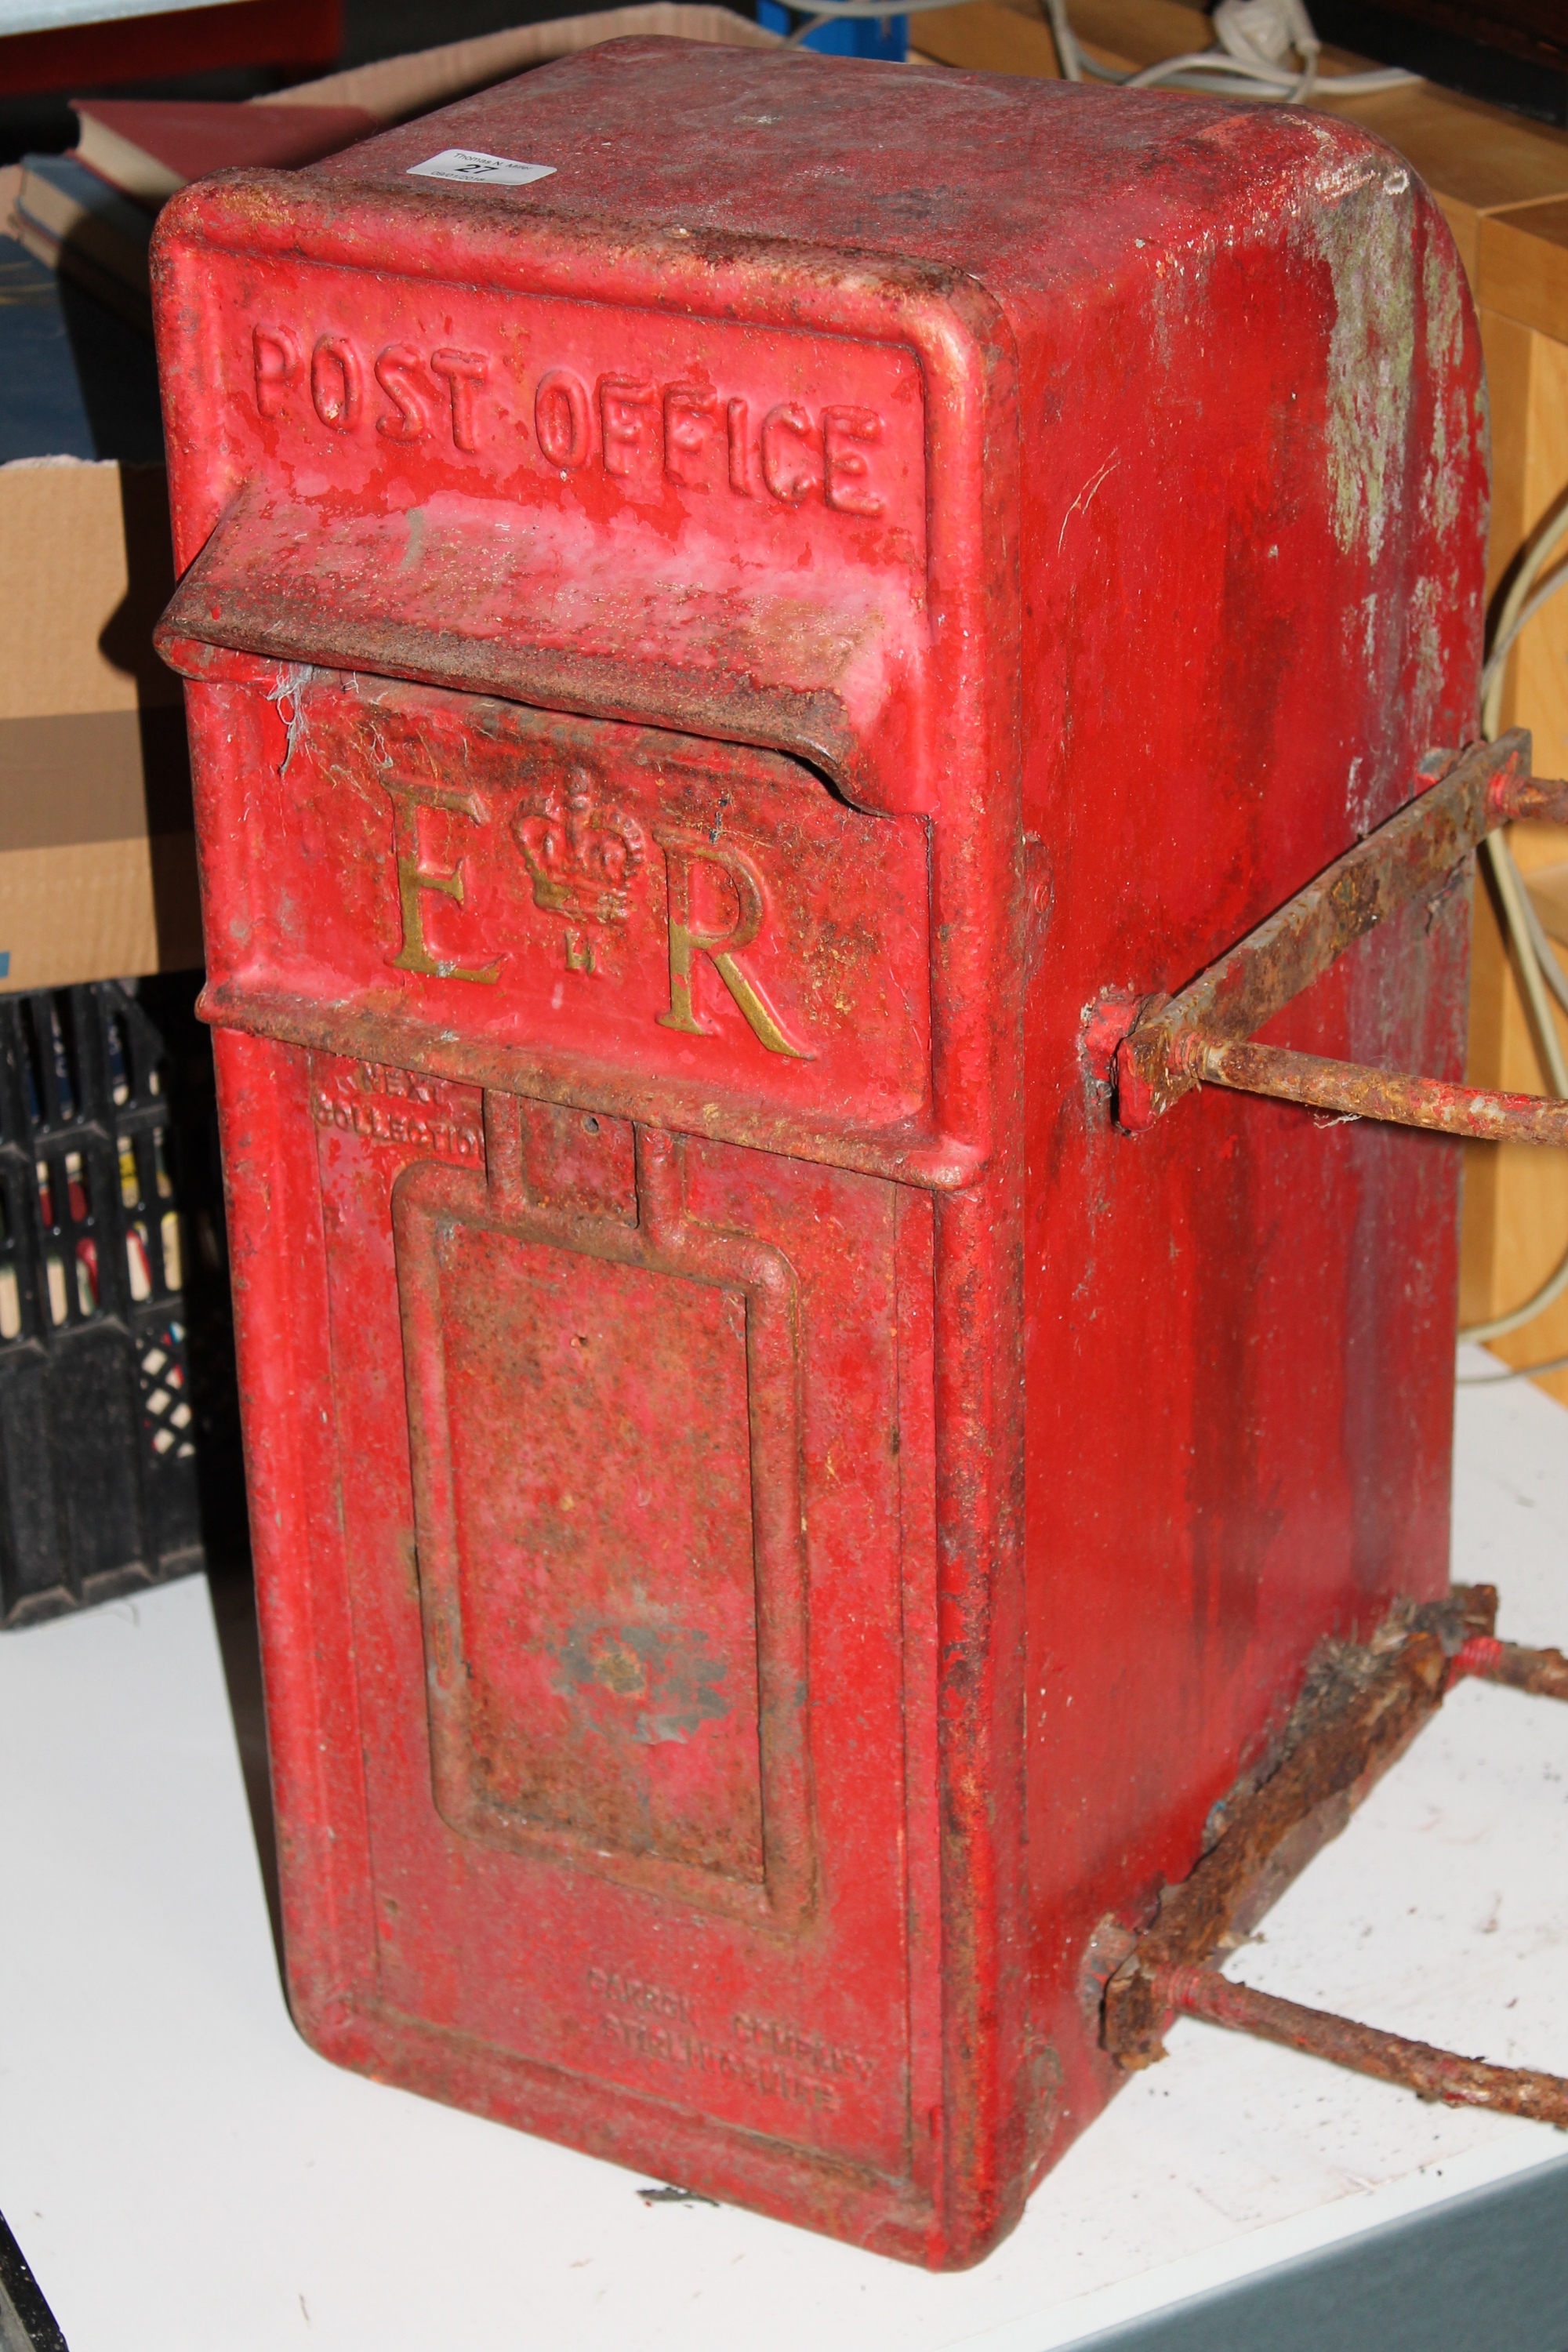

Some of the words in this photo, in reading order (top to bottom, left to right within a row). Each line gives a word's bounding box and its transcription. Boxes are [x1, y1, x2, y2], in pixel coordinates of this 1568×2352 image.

[453, 152, 492, 165] Thomas
[506, 162, 533, 171] Miller
[454, 164, 499, 174] 27
[252, 322, 488, 452] POST
[535, 368, 887, 517] OFFICE
[379, 768, 510, 985] E
[652, 826, 819, 1061] R
